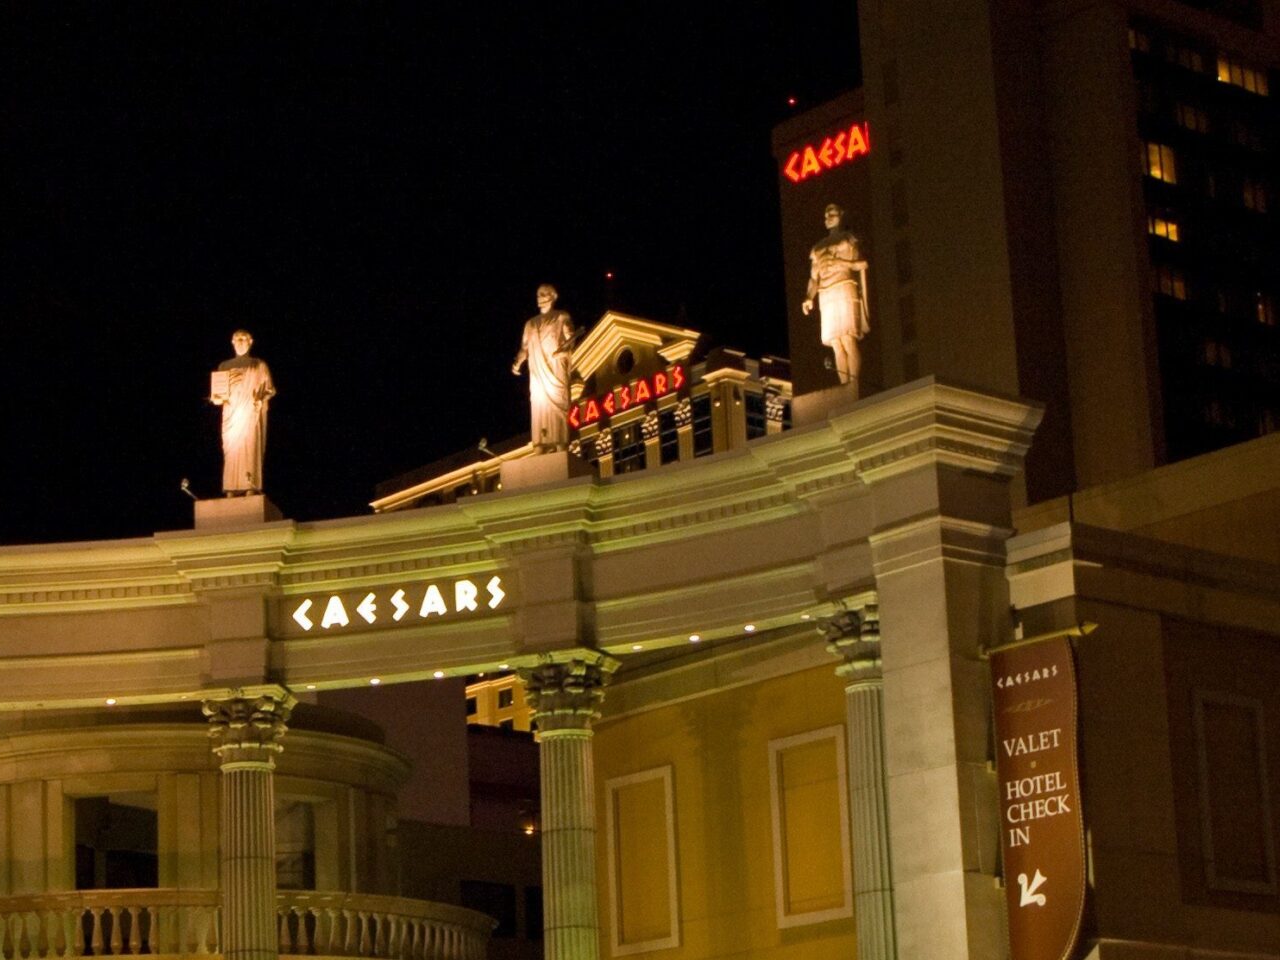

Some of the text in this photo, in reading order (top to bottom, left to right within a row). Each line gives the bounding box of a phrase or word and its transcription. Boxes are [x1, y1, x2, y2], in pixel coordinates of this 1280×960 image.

[783, 121, 870, 183] CAESA
[567, 365, 686, 428] CAESARS
[292, 575, 506, 631] CAESARS
[996, 664, 1058, 689] CAESARS
[1003, 728, 1061, 757] VALET
[1006, 771, 1067, 800] HOTEL
[1006, 794, 1071, 824] CHECK
[1008, 826, 1030, 848] IN
